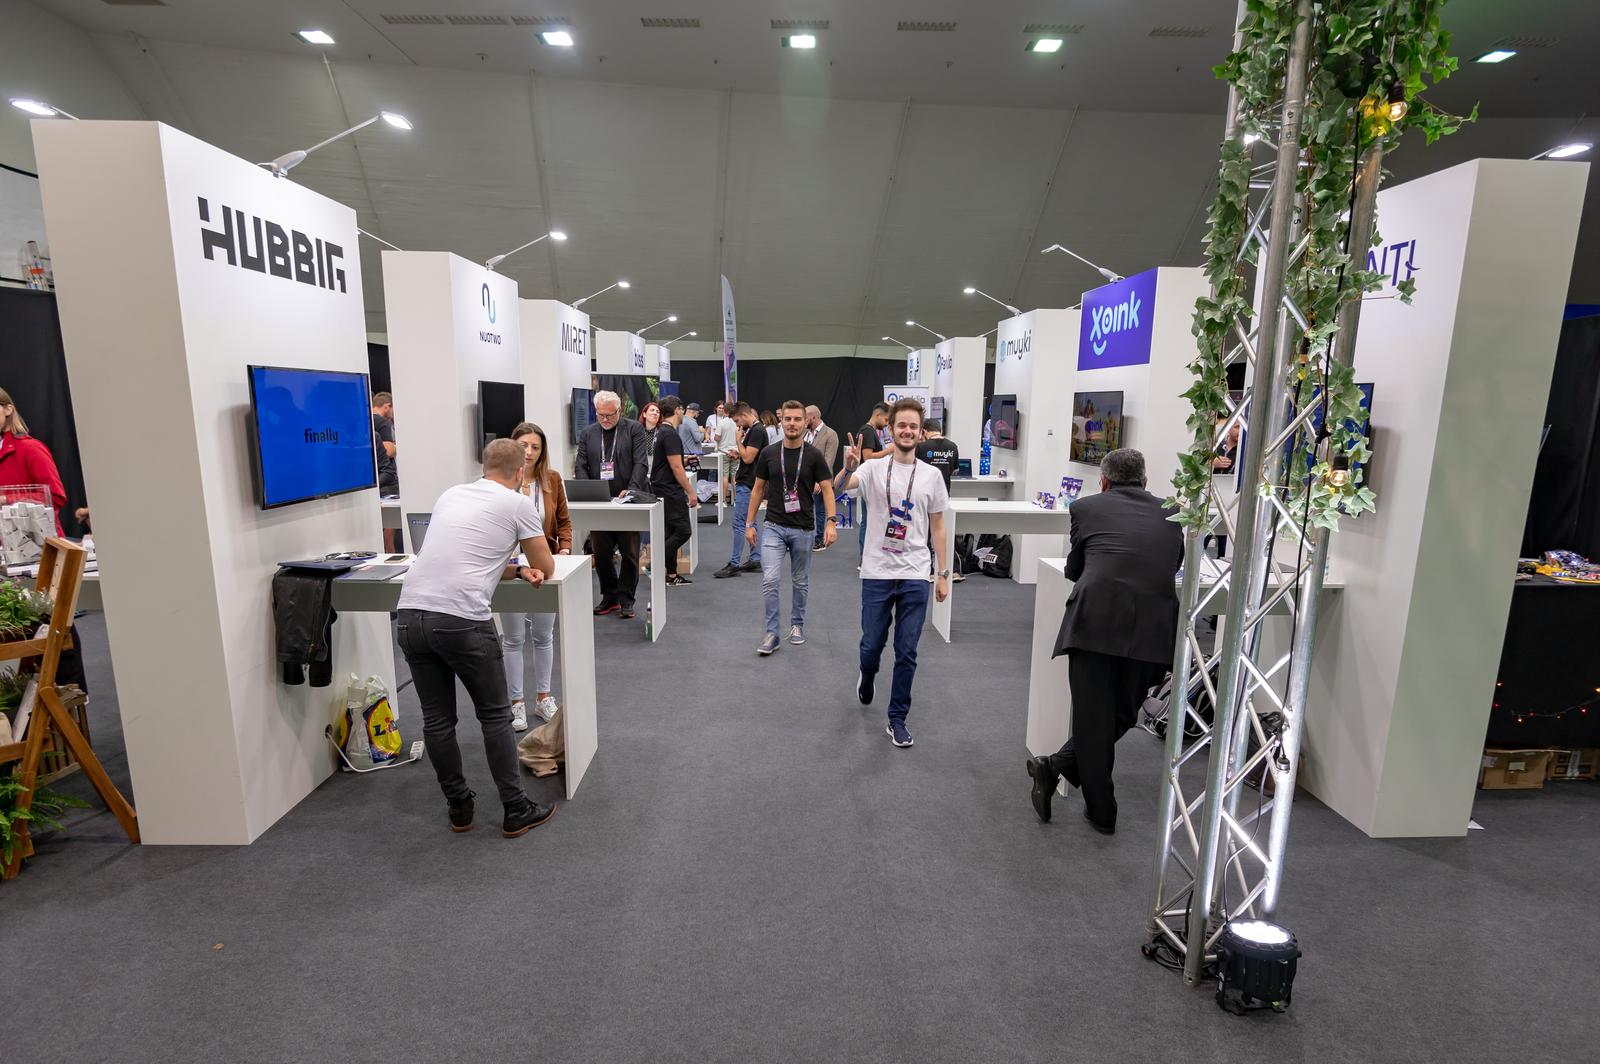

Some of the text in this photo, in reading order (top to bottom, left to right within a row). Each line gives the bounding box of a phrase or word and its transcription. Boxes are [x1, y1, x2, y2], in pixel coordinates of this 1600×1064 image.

[197, 196, 347, 294] HUBBIG
[561, 321, 587, 356] MIRET
[1006, 329, 1031, 360] muyki
[304, 427, 338, 445] finally
